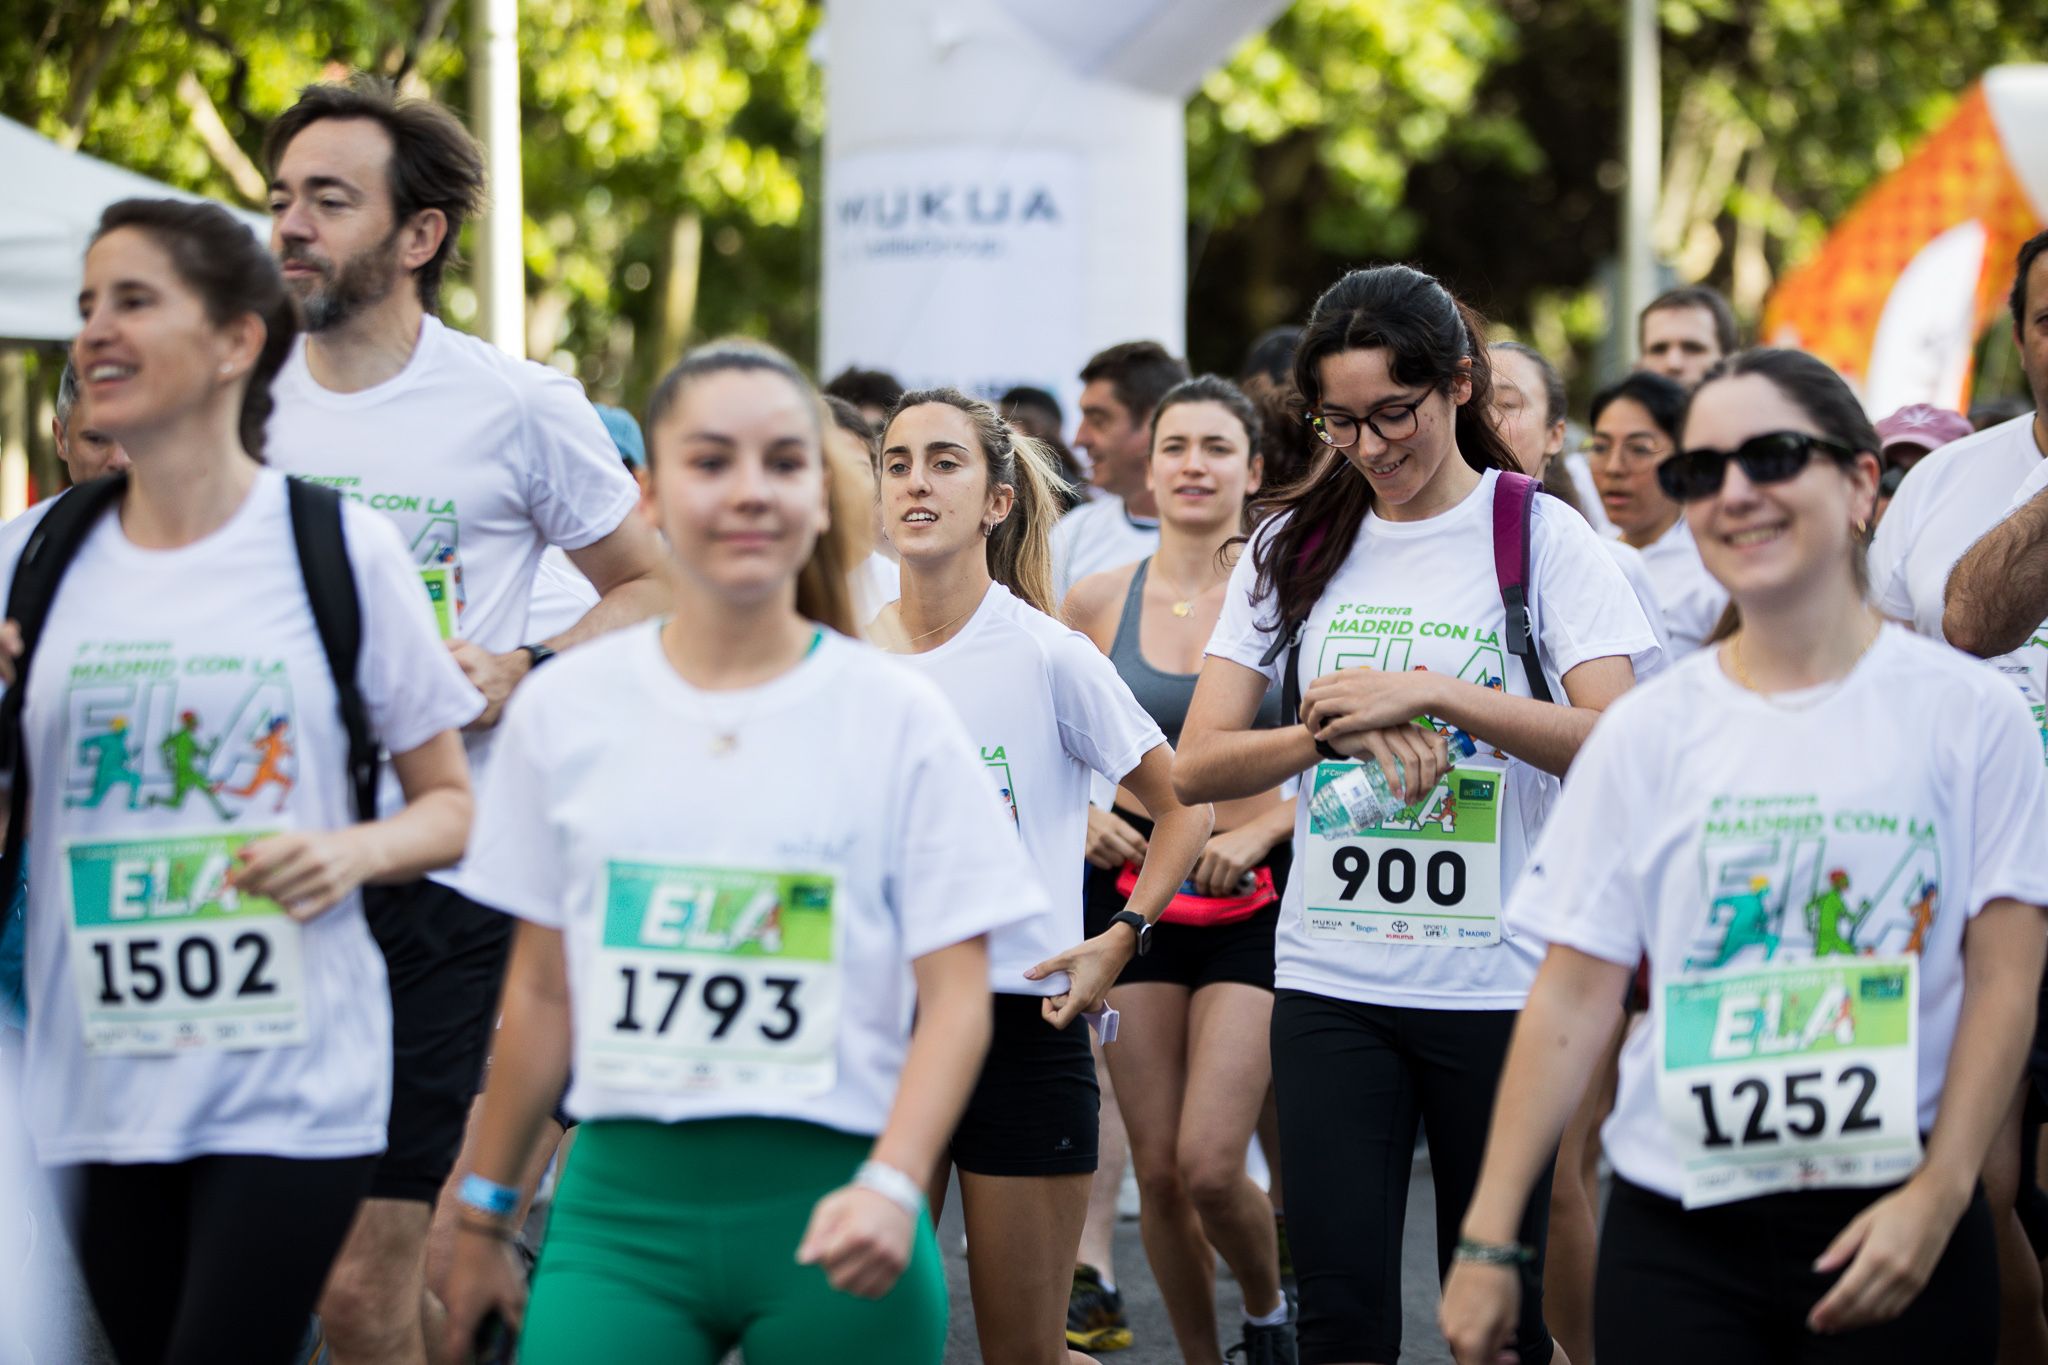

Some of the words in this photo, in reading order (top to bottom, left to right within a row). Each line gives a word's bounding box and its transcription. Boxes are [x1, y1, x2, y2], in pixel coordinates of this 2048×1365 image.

[370, 494, 420, 511] CON
[427, 499, 455, 514] LA
[1355, 604, 1413, 616] Carrera
[1328, 619, 1414, 635] MADRID
[1420, 623, 1469, 640] CON
[1475, 628, 1499, 647] LA
[71, 659, 176, 679] MADRID
[186, 656, 243, 676] CON
[254, 660, 286, 674] LA
[980, 745, 1006, 760] LA
[1706, 814, 1823, 834] MADRID
[1834, 811, 1897, 833] CON
[1908, 818, 1936, 838] LA
[110, 853, 239, 918] ELA
[1332, 845, 1467, 906] 900
[640, 883, 783, 953] ELA
[1312, 919, 1342, 927] MUKUA
[92, 932, 276, 1005] 1502
[615, 968, 800, 1042] 1793
[1711, 985, 1856, 1058] ELA
[1691, 1066, 1881, 1149] 1252
